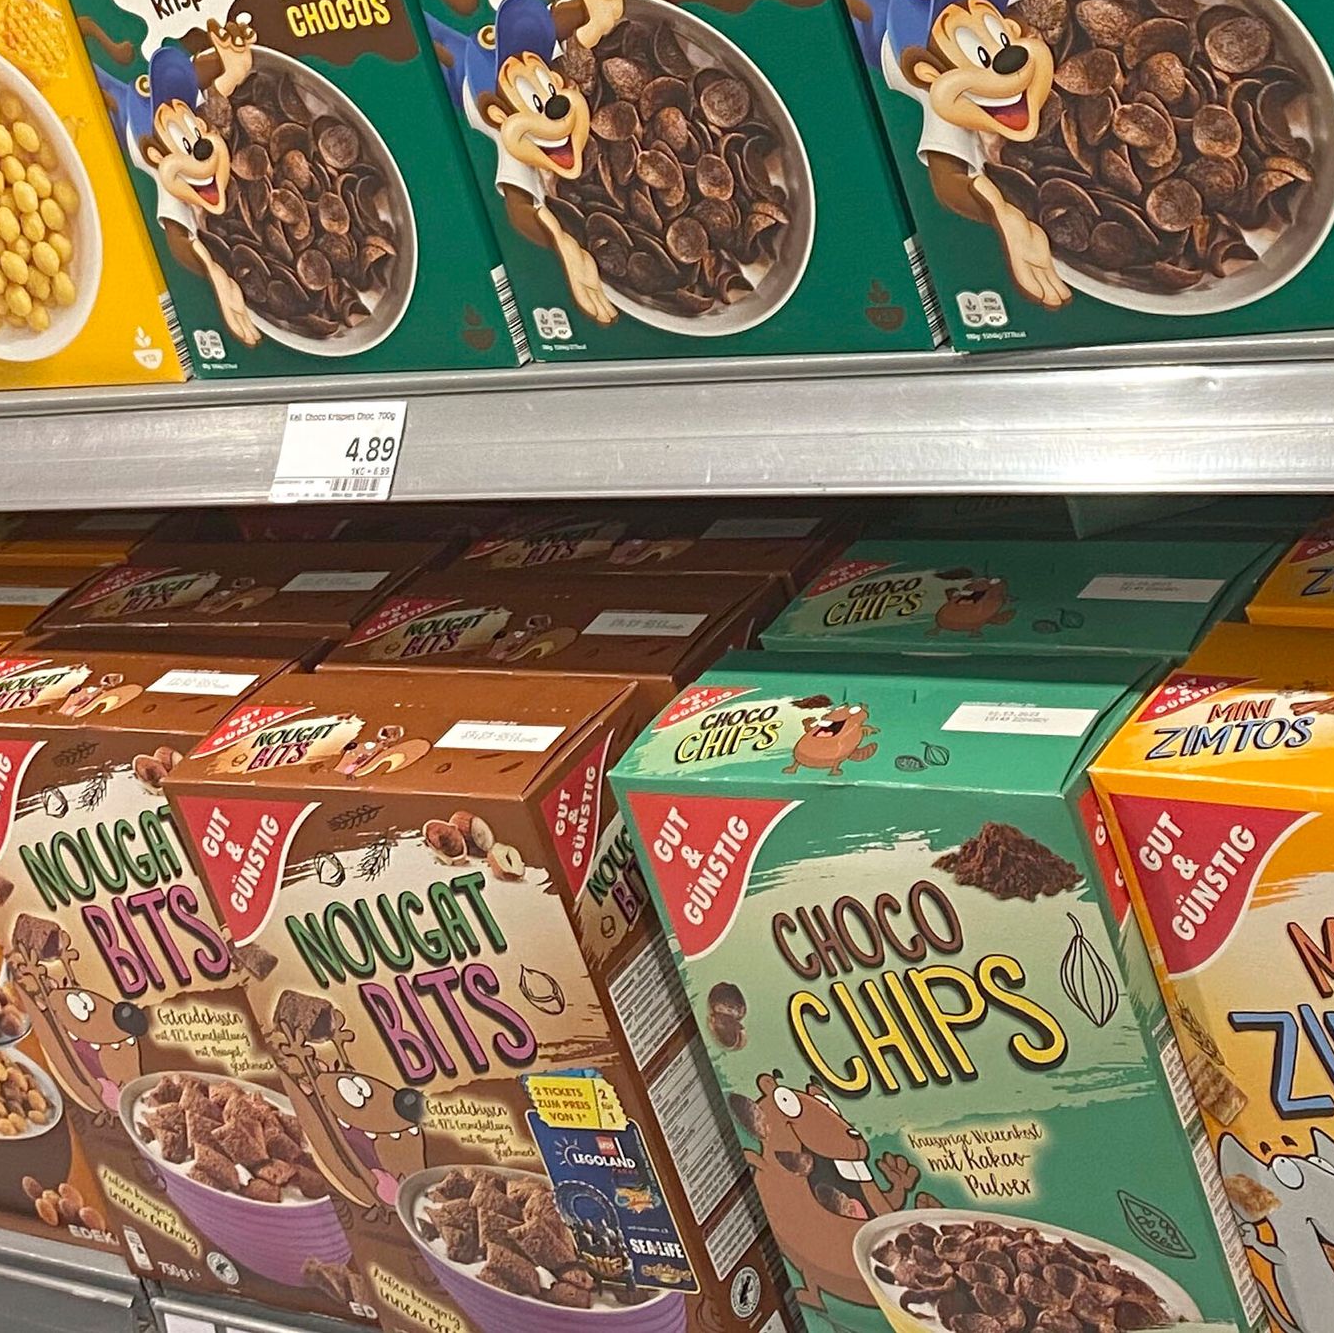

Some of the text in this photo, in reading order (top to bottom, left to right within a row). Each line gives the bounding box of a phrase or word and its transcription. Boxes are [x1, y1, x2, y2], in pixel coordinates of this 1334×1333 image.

[346, 437, 395, 462] 4.89
[823, 590, 924, 624] CHIPS
[847, 576, 922, 600] CHOCO
[700, 705, 778, 730] CHOCO
[1208, 698, 1275, 723] MINI
[251, 722, 340, 749] NOUGAT
[675, 722, 781, 764] CHIPS
[1145, 717, 1313, 760] ZIMTOS
[247, 744, 312, 771] BITS
[201, 807, 232, 857] GUT
[652, 806, 691, 867] GUT
[1138, 809, 1186, 872] GUT
[230, 813, 280, 914] GÜNSTIG
[682, 816, 752, 929] GÜNSTIG
[1170, 824, 1259, 943] GÜNSTIG
[81, 884, 231, 1000] BITS
[286, 871, 509, 989] NOUGAT
[772, 879, 964, 981] CHOCO
[361, 962, 539, 1086] BITS
[789, 955, 1066, 1098] CHIPS
[572, 1153, 636, 1169] LEGOLAND
[928, 1150, 963, 1172] mit
[965, 1173, 1030, 1198] Pulver
